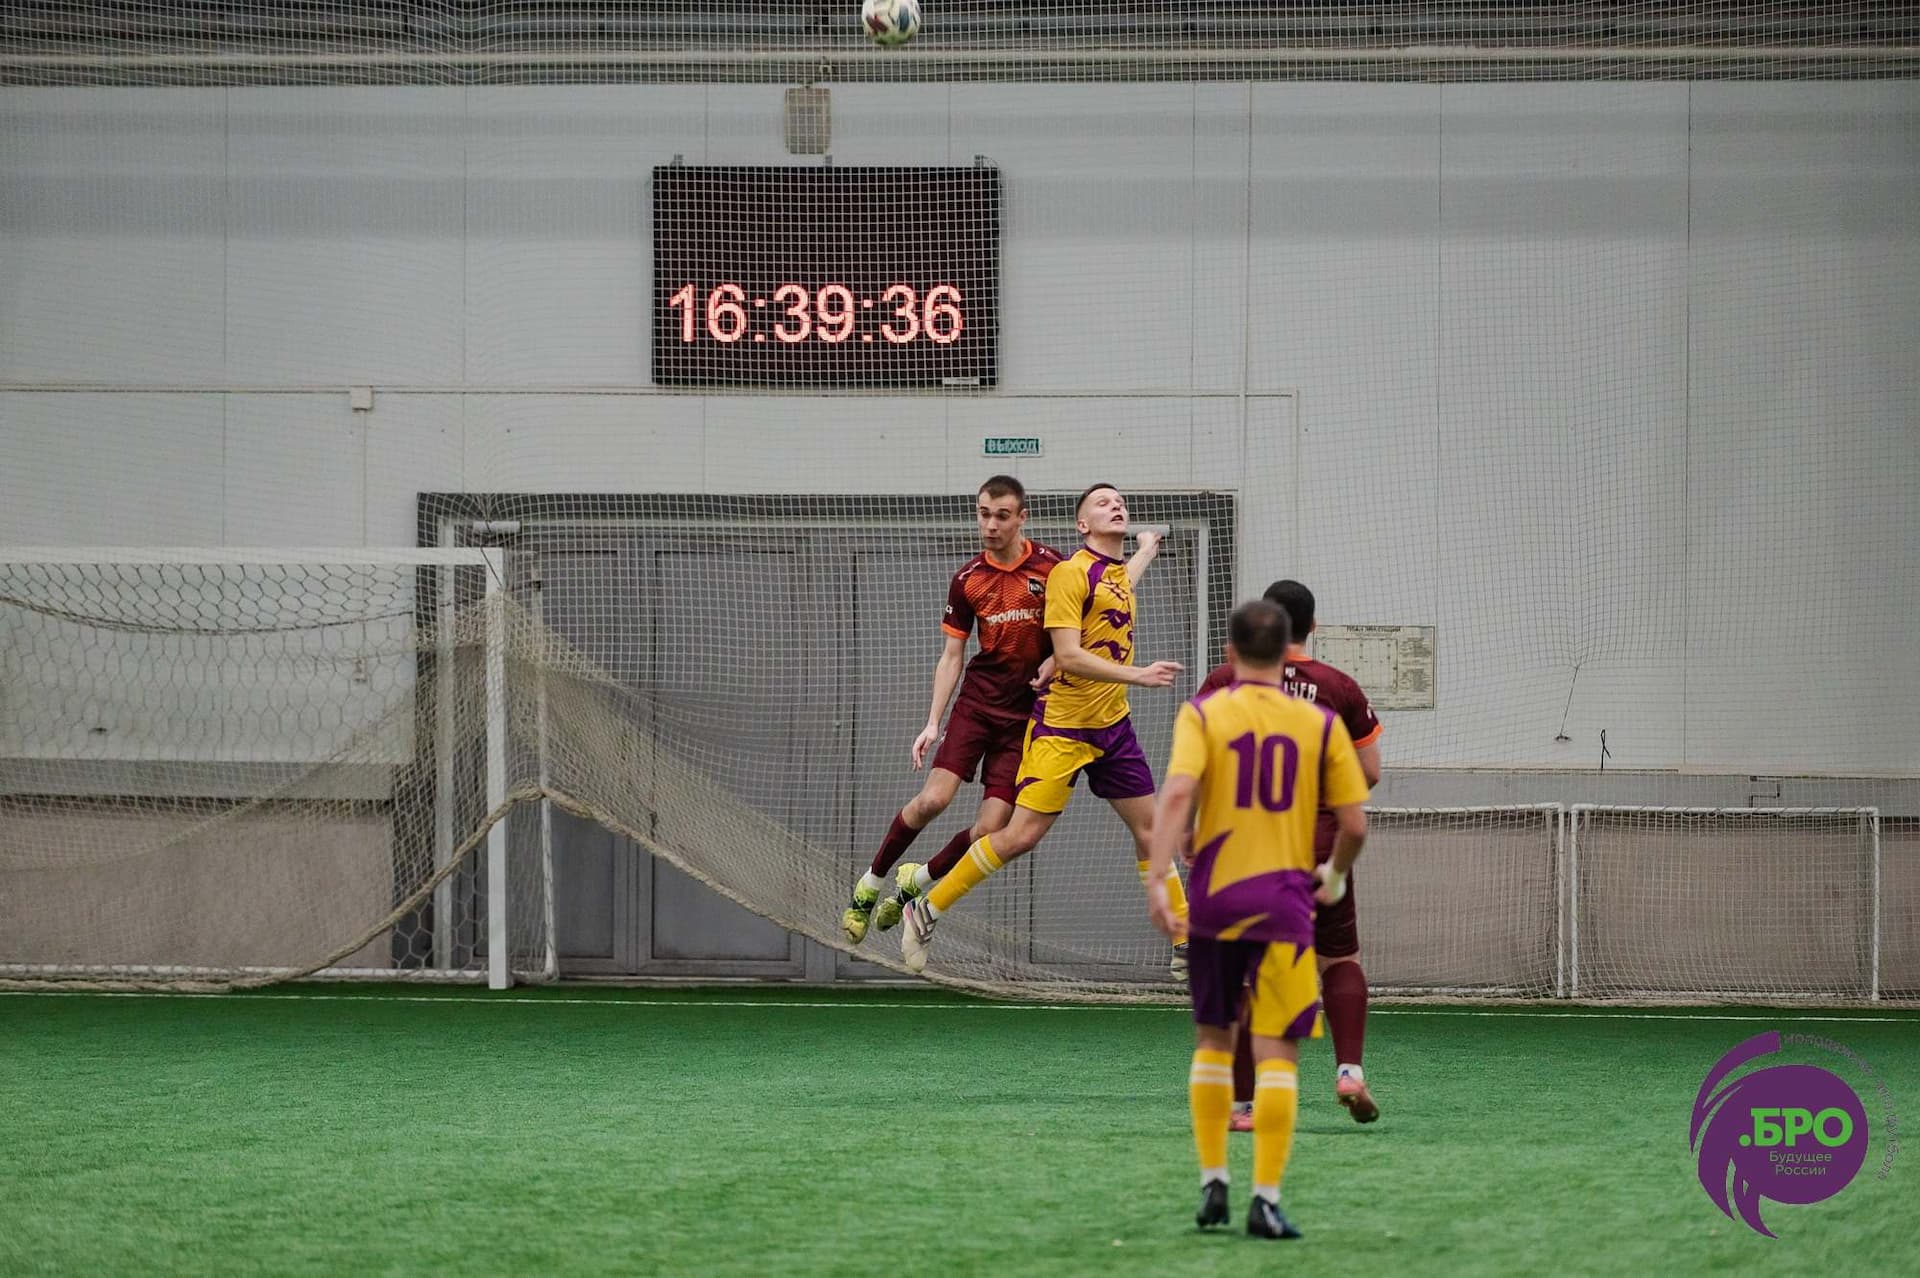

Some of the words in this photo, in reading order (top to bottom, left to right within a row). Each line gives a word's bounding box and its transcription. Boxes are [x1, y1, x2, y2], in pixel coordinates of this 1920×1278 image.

[669, 284, 964, 344] 16:39:36
[986, 438, 1038, 453] ВЫХОД
[1228, 731, 1298, 812] 10
